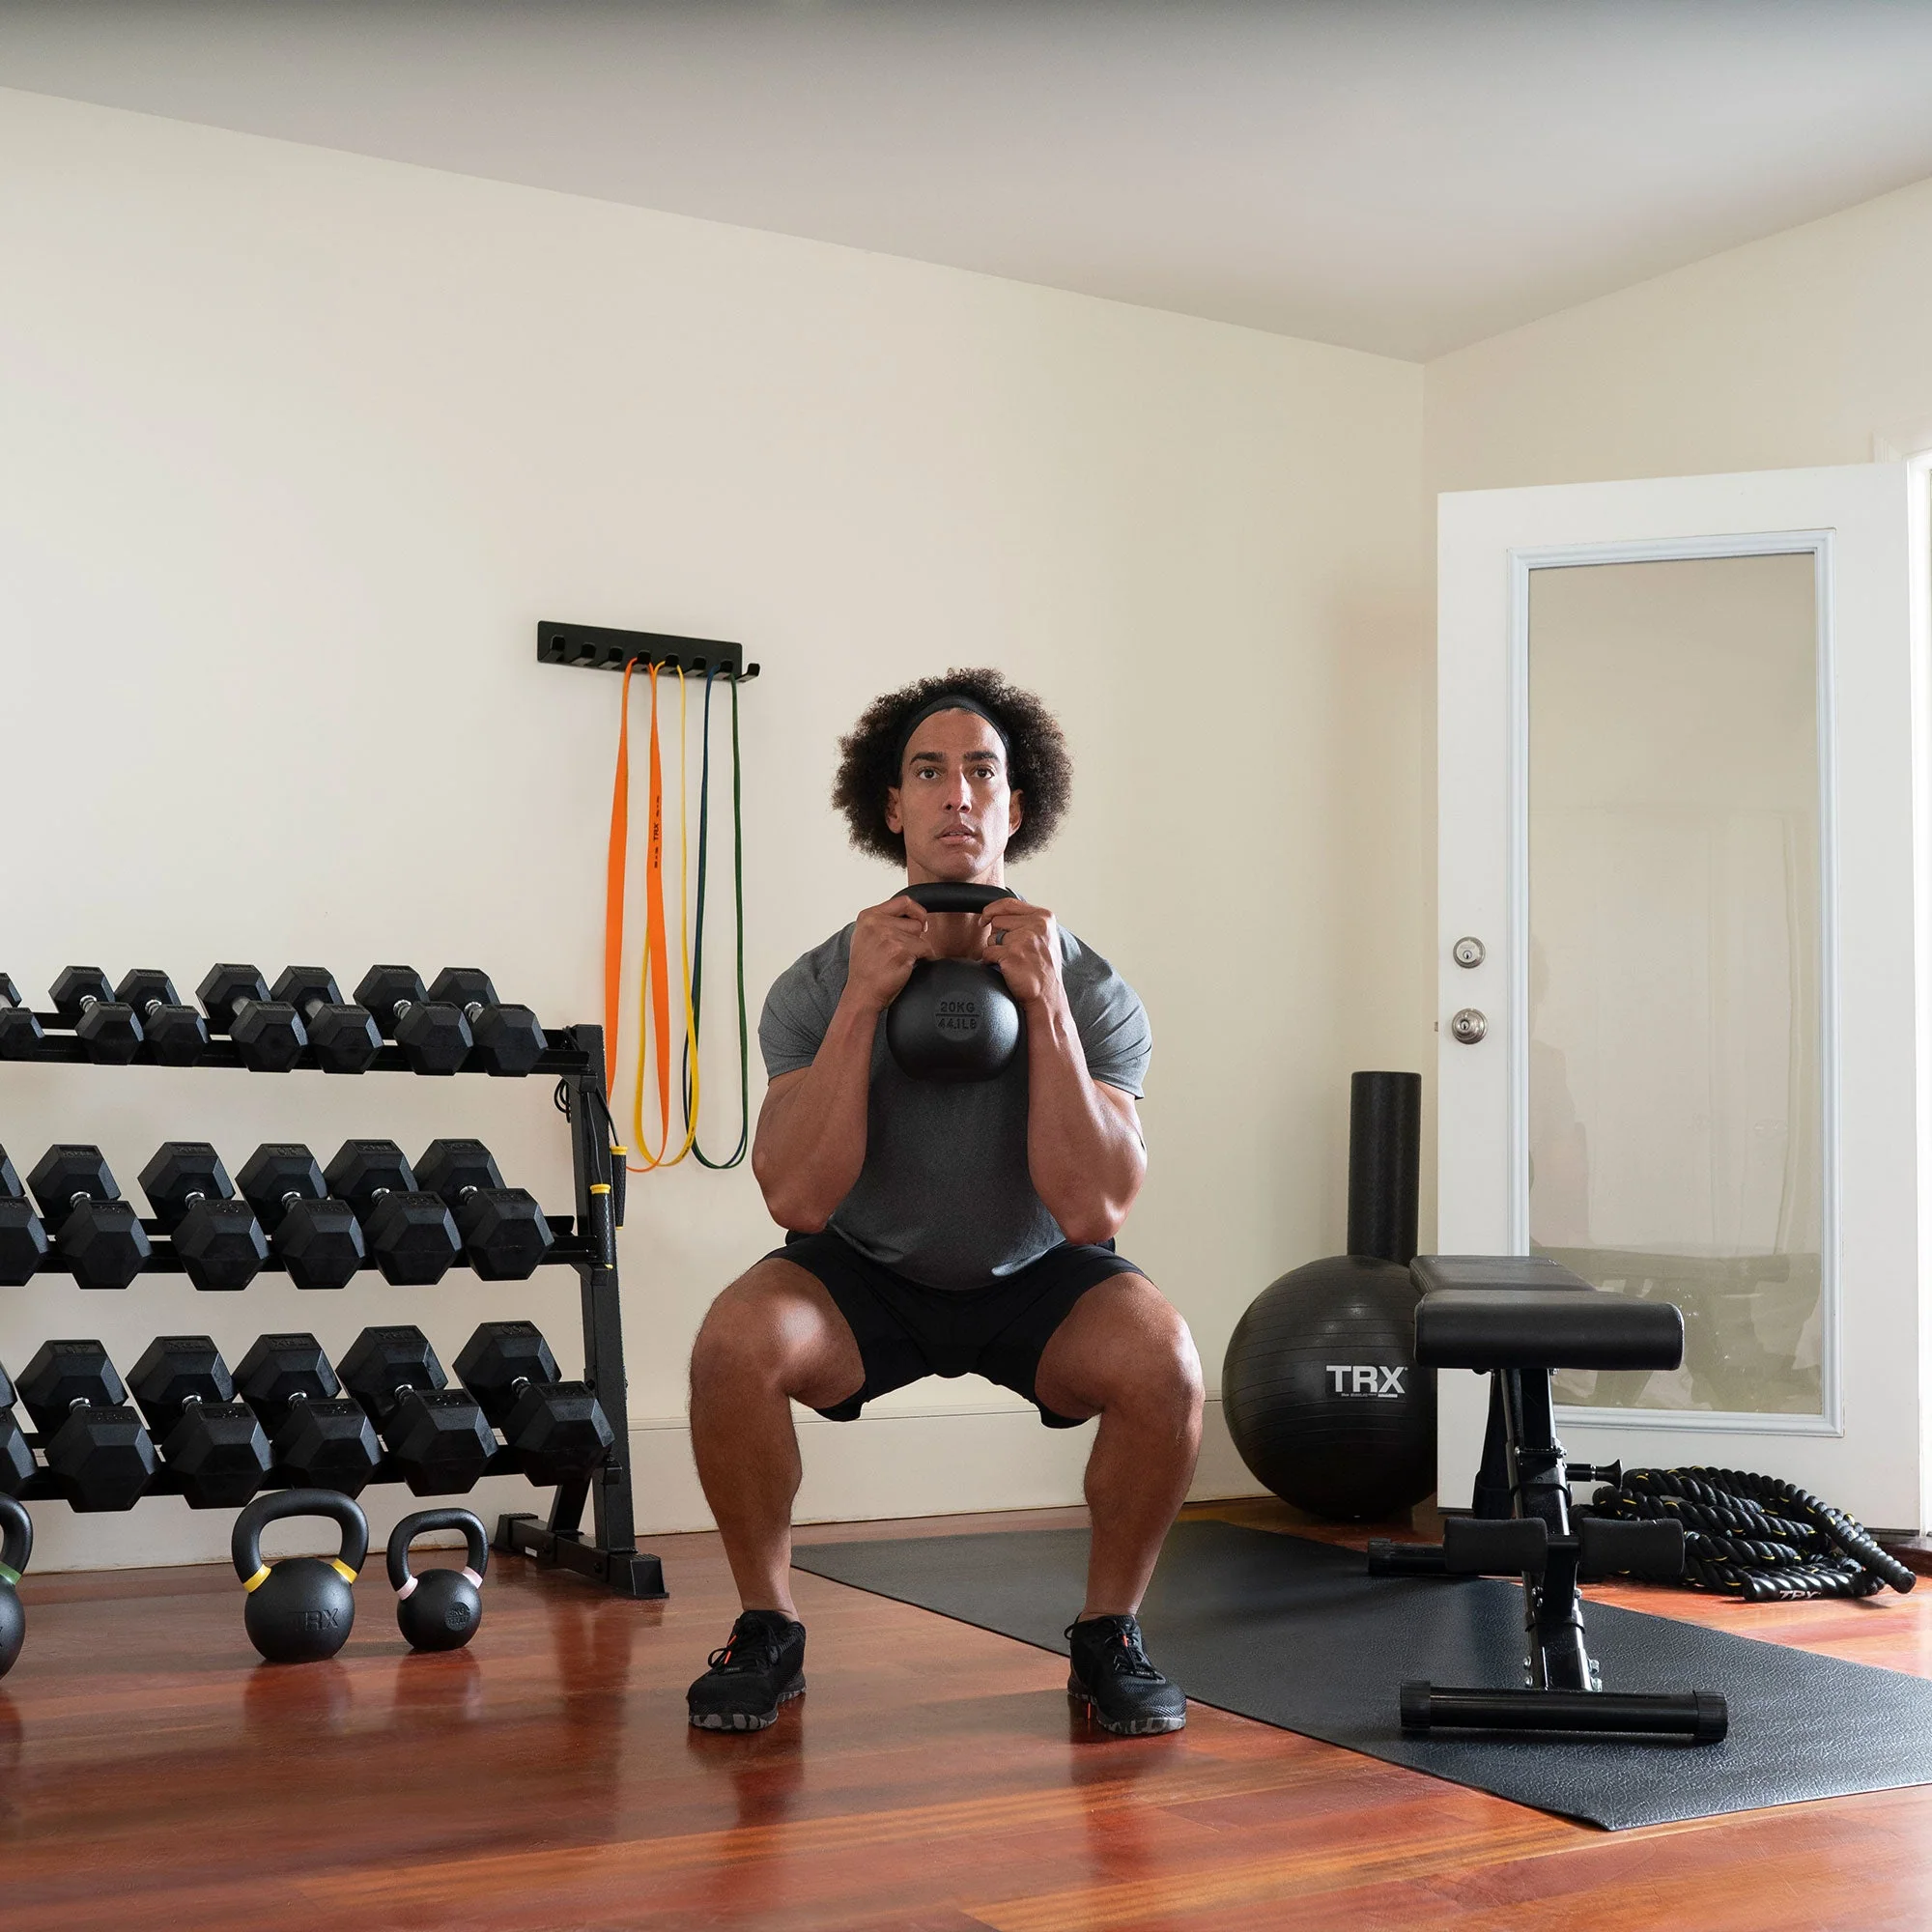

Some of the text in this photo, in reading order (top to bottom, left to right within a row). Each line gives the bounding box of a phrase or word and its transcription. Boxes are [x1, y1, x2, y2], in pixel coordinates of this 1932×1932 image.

[940, 1001, 976, 1013] 20KG
[937, 1018, 979, 1031] 44.1LB
[1326, 1365, 1406, 1394] TRX
